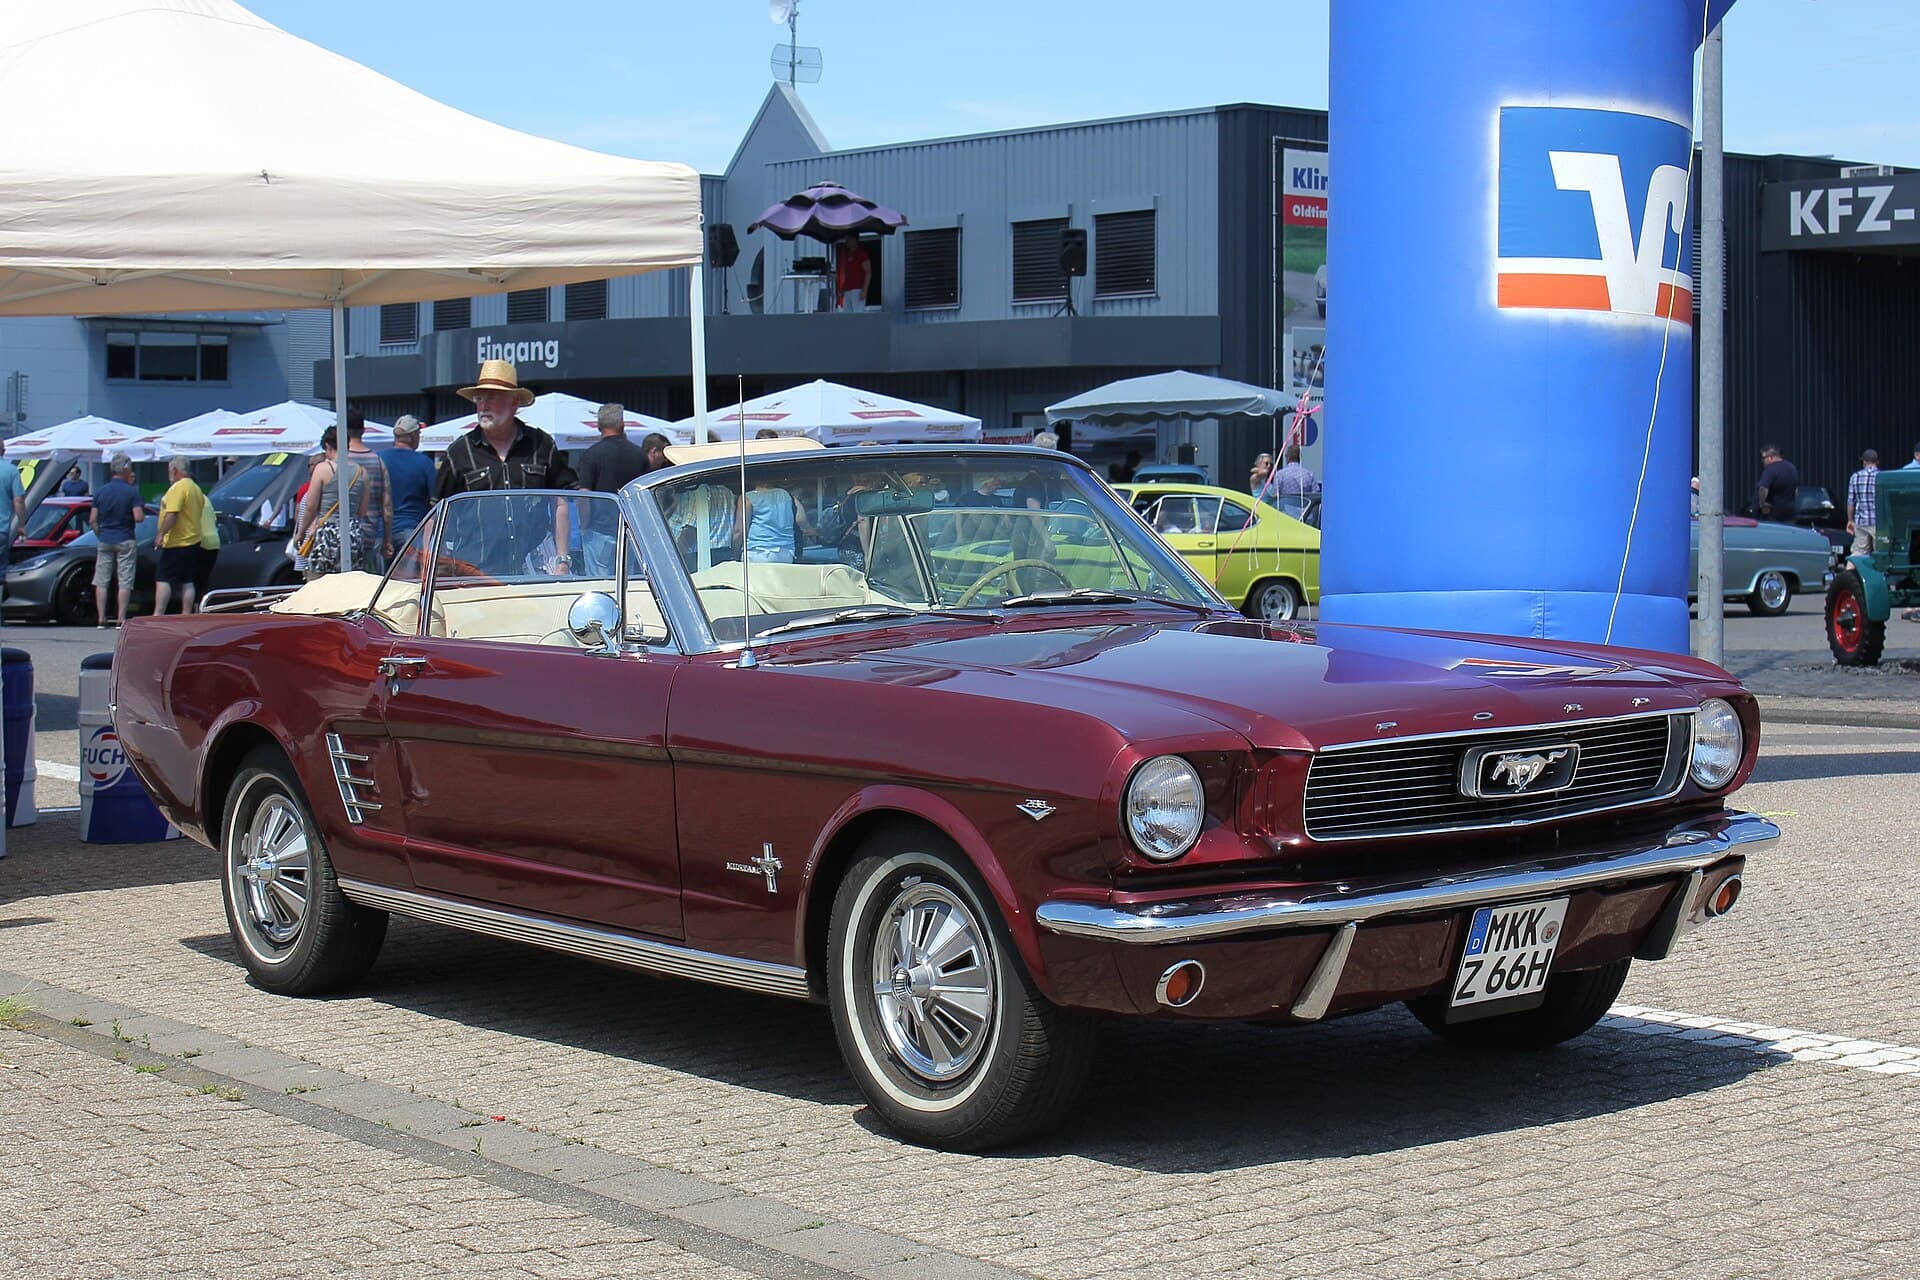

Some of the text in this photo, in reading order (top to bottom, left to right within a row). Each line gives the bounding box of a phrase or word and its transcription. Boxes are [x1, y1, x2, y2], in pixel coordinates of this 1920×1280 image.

[1790, 185, 1915, 236] KFZ-
[477, 335, 559, 369] Eingang
[82, 747, 129, 765] FUCH
[1472, 938, 1480, 949] D
[1483, 906, 1547, 955] MKK
[1456, 948, 1553, 1001] Z 66H
